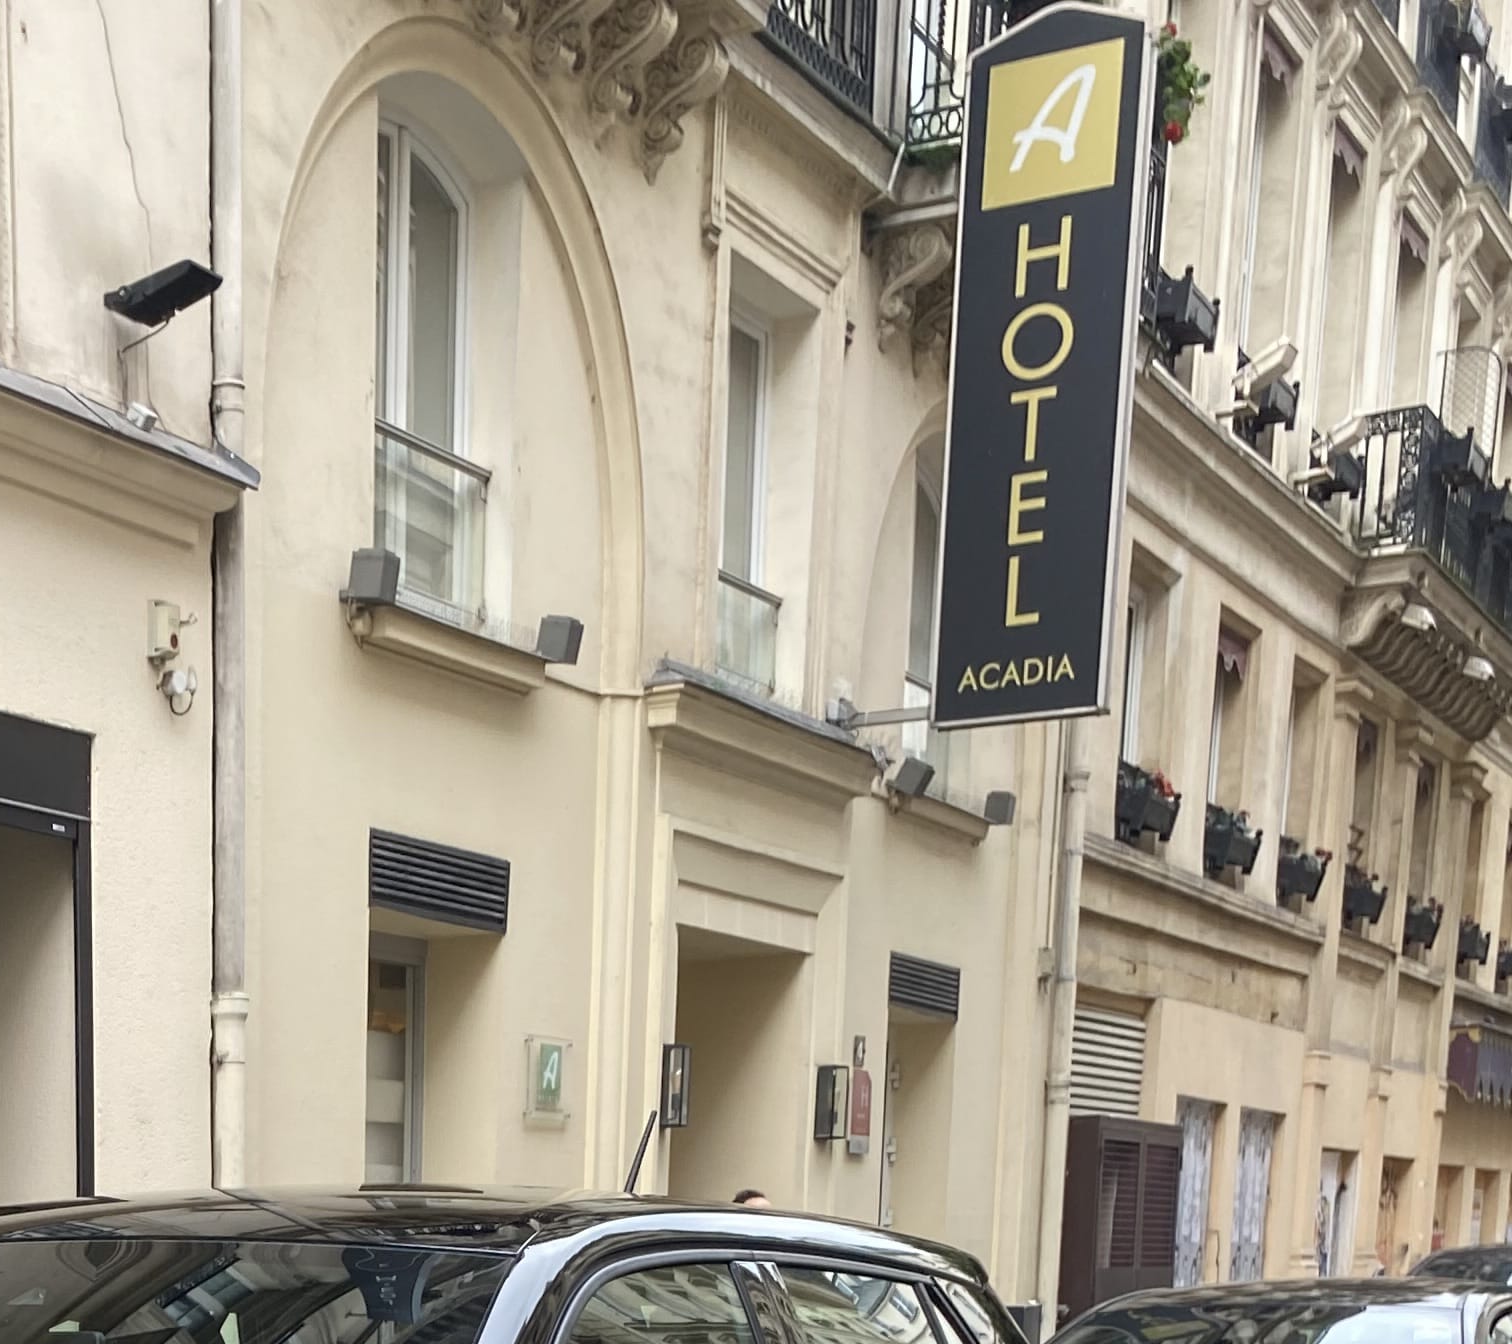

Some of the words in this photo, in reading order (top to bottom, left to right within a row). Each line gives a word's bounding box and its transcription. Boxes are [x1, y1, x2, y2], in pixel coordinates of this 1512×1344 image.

[1009, 63, 1096, 173] A
[1001, 215, 1074, 628] HOTEL
[957, 653, 1075, 694] ACADIA
[543, 1051, 559, 1090] A
